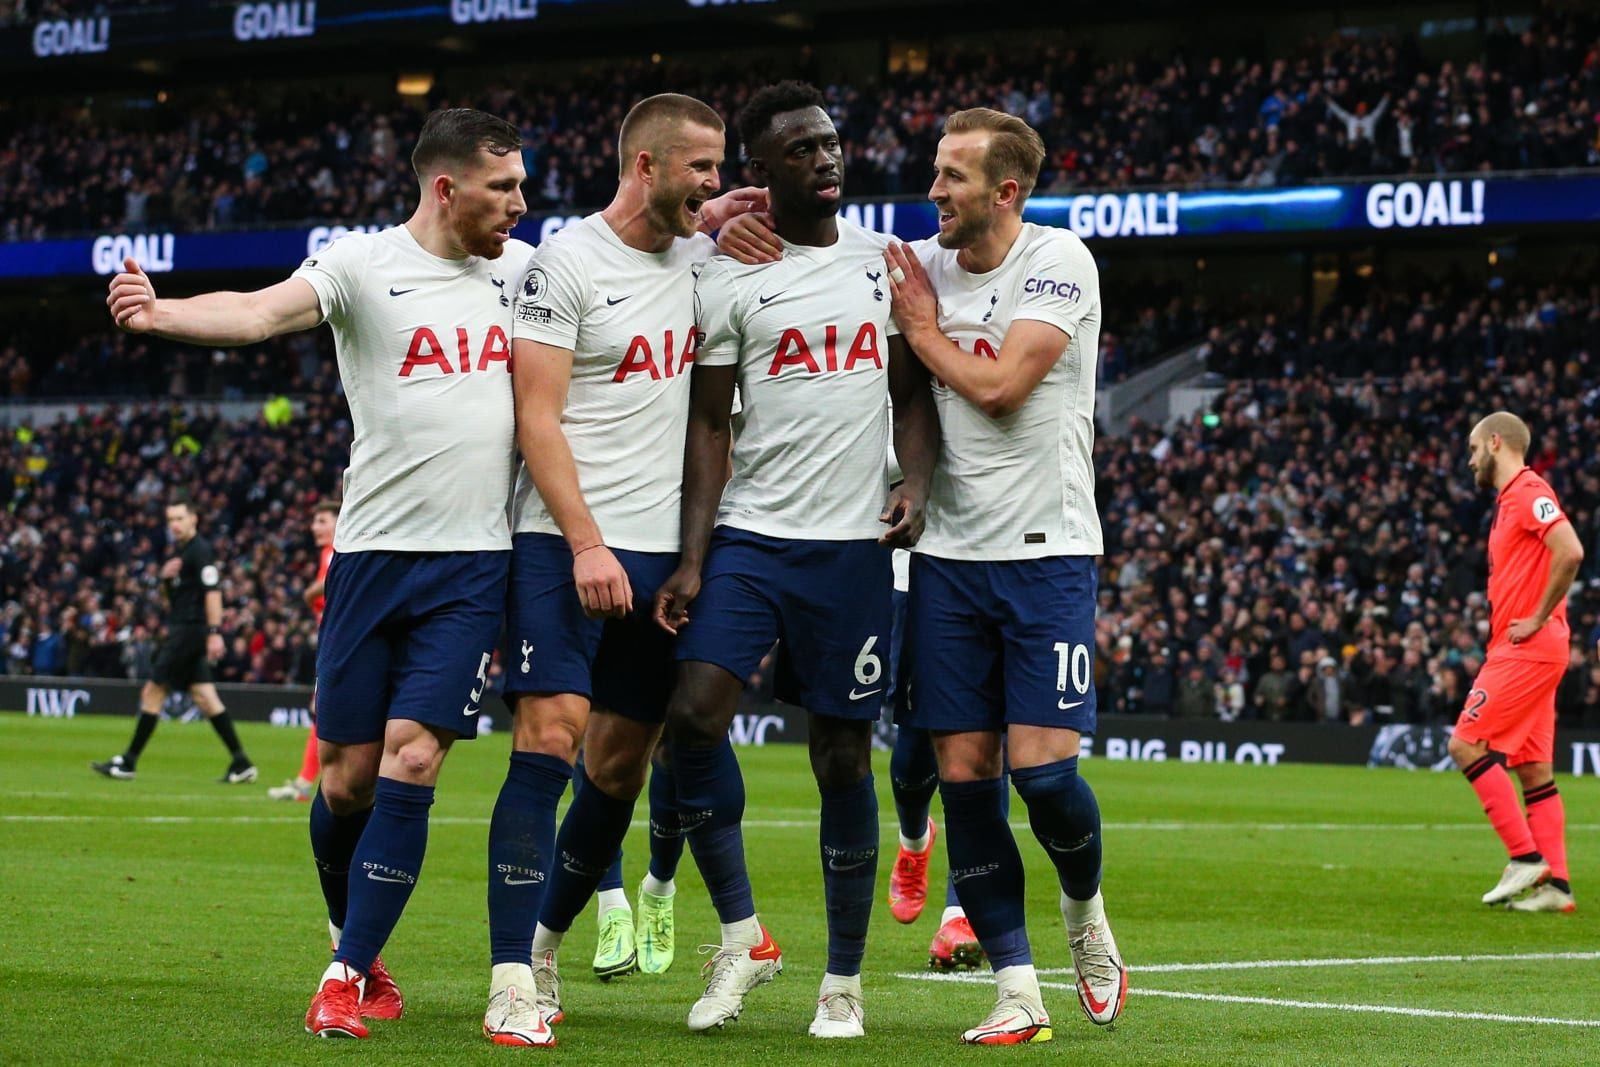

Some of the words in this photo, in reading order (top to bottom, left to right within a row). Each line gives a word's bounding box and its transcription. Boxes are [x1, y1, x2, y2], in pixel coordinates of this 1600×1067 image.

[33, 18, 110, 56] GOAL!
[234, 3, 316, 40] GOAL!
[1069, 192, 1179, 238] GOAL!
[1367, 180, 1485, 228] GOAL!
[92, 233, 175, 275] GOAL!
[1024, 277, 1082, 303] cinch
[398, 325, 513, 377] AIA
[767, 321, 883, 377] AIA
[1540, 502, 1555, 520] JD
[468, 651, 492, 703] 5
[854, 635, 882, 685] 6
[1053, 641, 1091, 695] 10
[26, 687, 91, 719] IWC
[729, 714, 785, 746] WC
[1106, 738, 1168, 762] BIG
[362, 861, 415, 884] SPURS
[497, 863, 545, 881] SPURS
